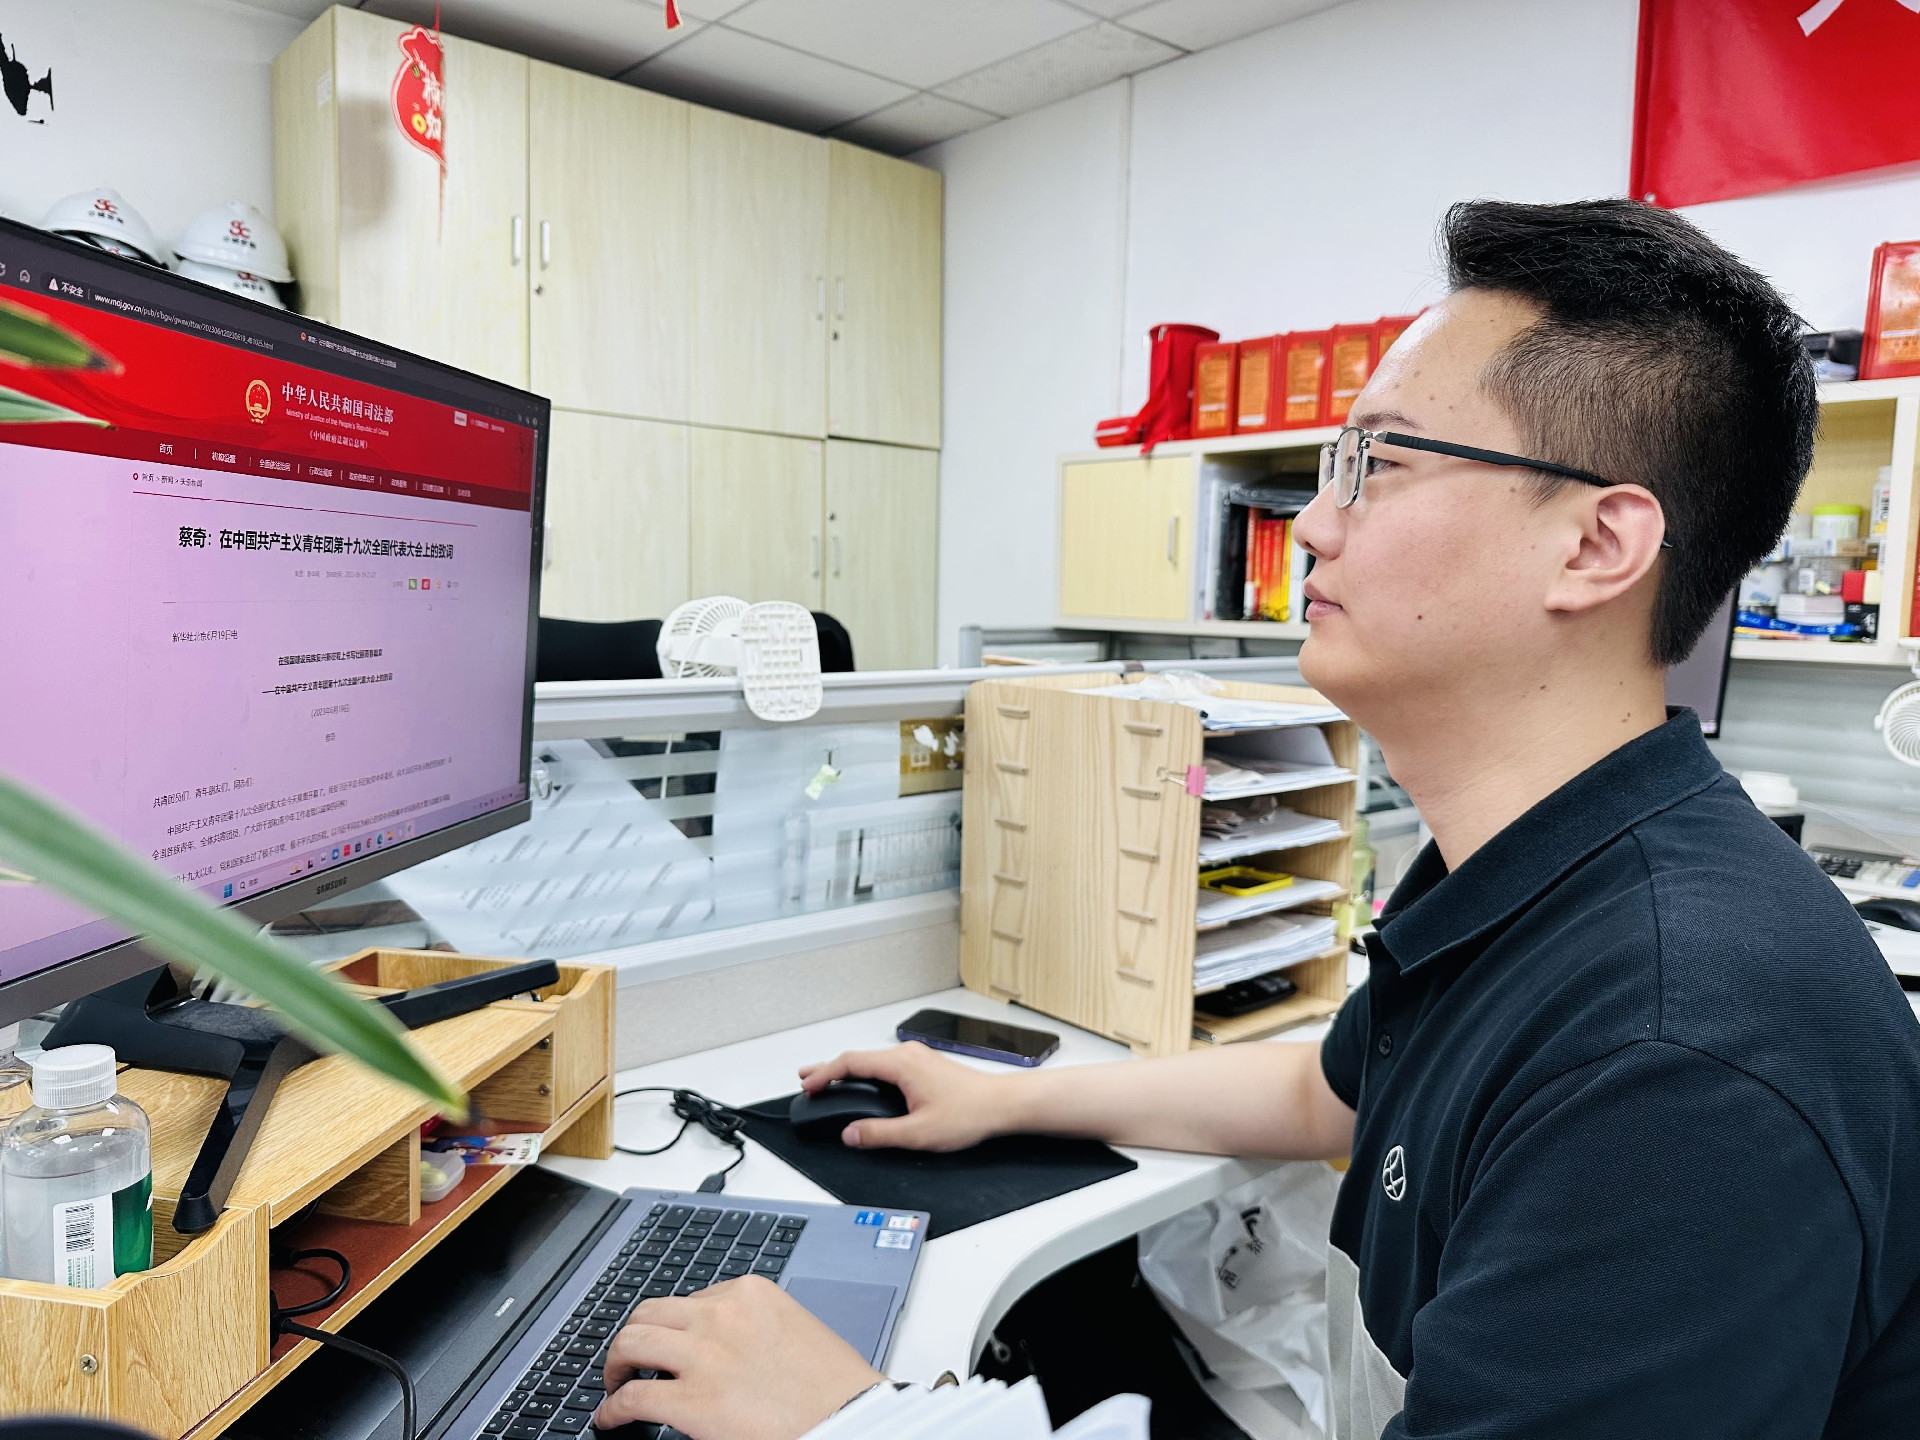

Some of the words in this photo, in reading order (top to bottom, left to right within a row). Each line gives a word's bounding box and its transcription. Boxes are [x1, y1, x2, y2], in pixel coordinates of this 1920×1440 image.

[61, 282, 84, 298] 不安全
[282, 381, 394, 425] 中华人民共和国司法部
[159, 443, 173, 455] 首页
[212, 451, 236, 464] 机构设置
